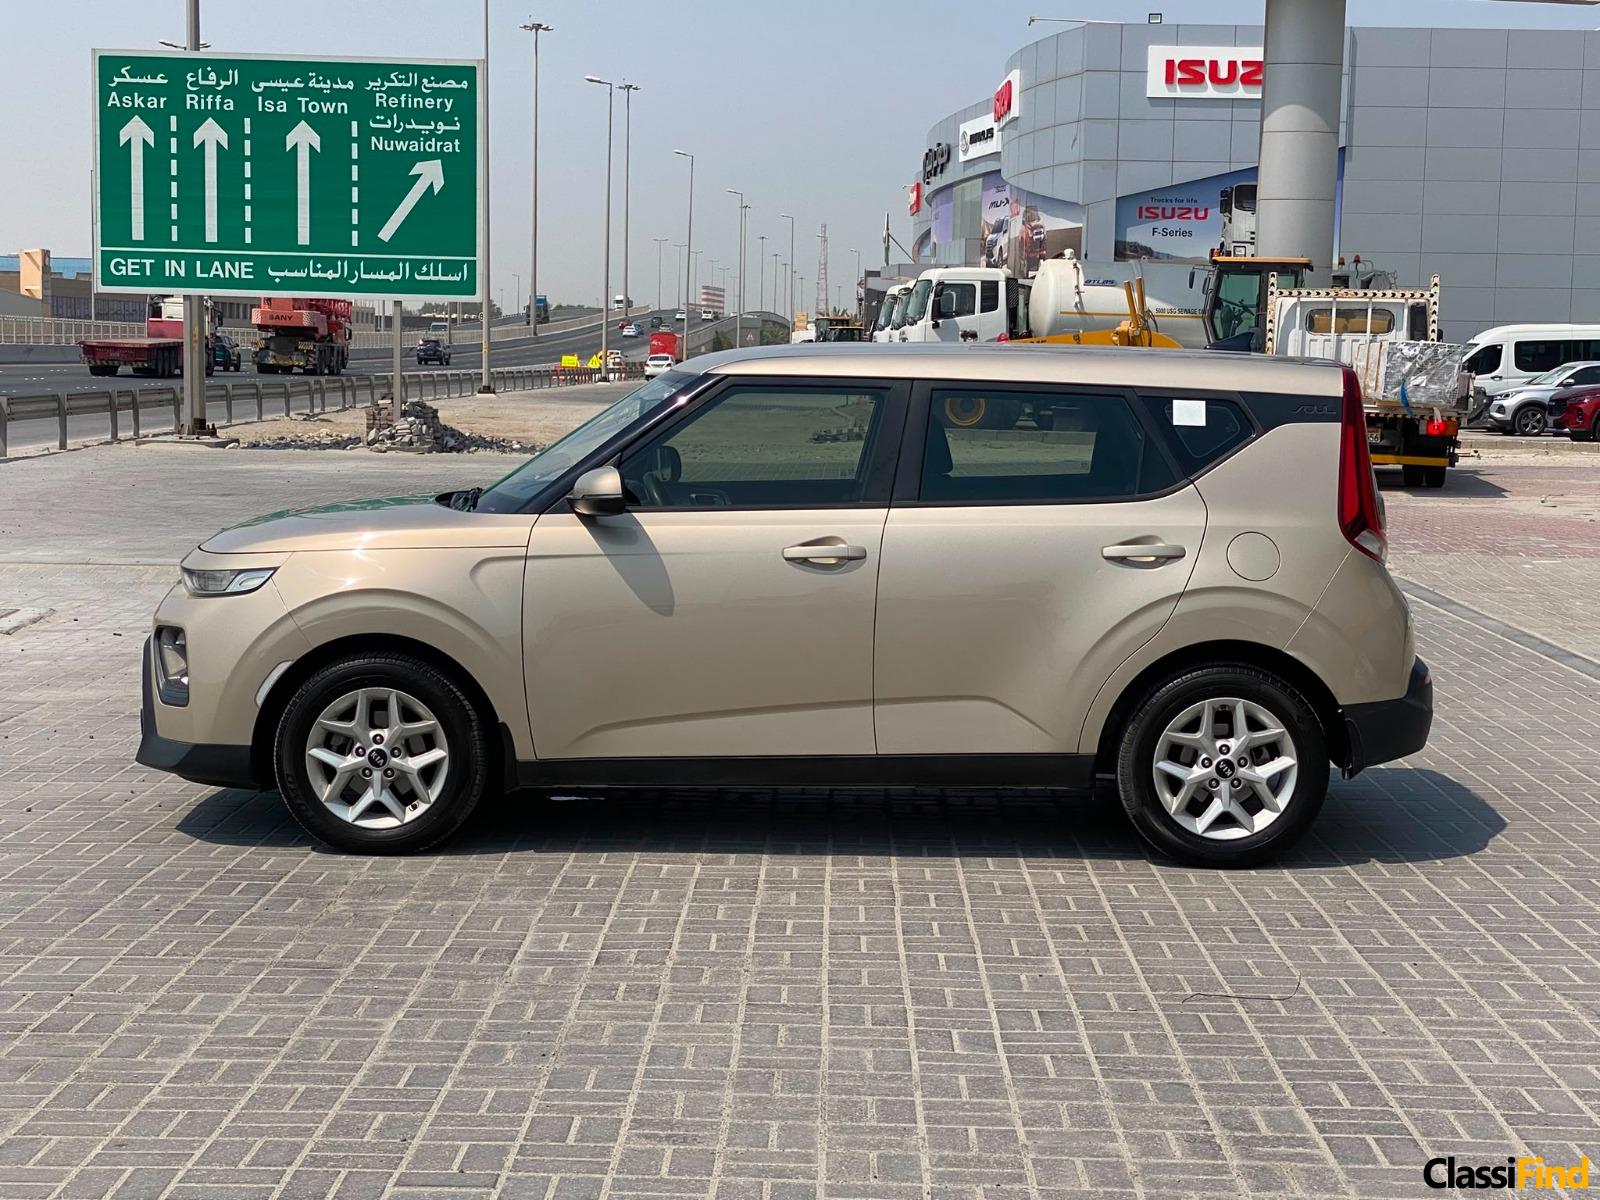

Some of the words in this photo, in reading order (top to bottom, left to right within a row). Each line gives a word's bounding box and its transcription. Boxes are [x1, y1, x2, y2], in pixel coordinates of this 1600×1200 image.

[108, 66, 169, 87] عسكر
[186, 66, 239, 91] الرفاع
[365, 71, 418, 91] التكرير
[1164, 58, 1264, 85] ISUZ
[251, 77, 305, 93] عيسى
[308, 72, 354, 94] مدينة
[421, 76, 468, 93] مصنع
[107, 91, 167, 109] Askar
[186, 93, 234, 111] Riffa
[258, 96, 287, 113] Isa
[297, 97, 348, 114] Town
[375, 90, 453, 112] Refinery
[369, 113, 461, 135] نويدرات
[371, 136, 460, 153] Nuwaidrat
[1138, 206, 1209, 220] ISUZU
[1152, 227, 1193, 238] F-Series
[109, 257, 155, 276] GET
[165, 259, 186, 277] IN
[196, 260, 254, 279] LANE
[268, 259, 348, 284] المناسب
[348, 261, 410, 284] المسار
[414, 262, 468, 281] اسلك
